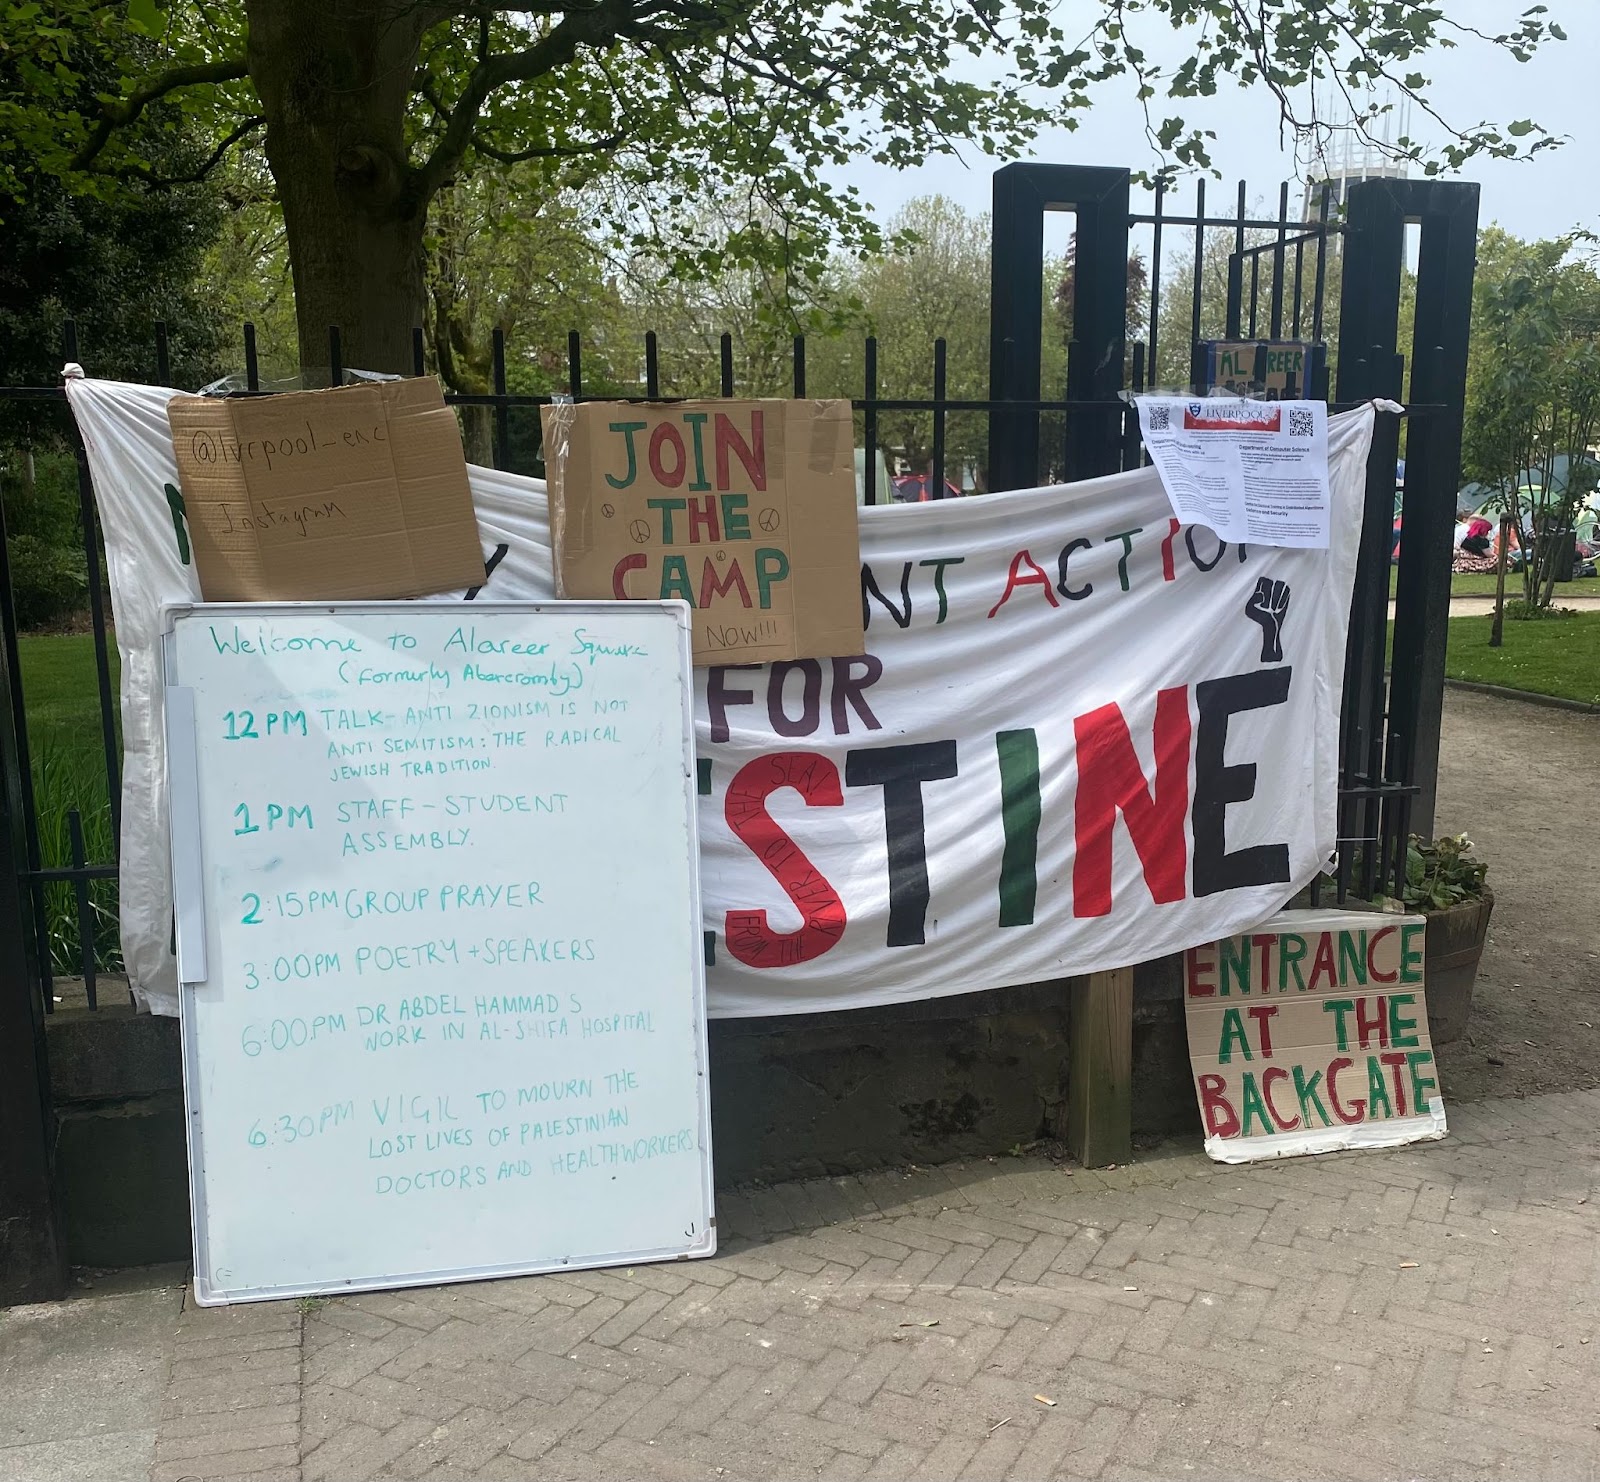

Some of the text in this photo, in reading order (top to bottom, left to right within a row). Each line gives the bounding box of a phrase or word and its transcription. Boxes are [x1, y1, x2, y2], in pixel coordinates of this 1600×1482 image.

[1220, 350, 1303, 377] ALREER
[1206, 408, 1264, 419] LIVERPOOL
[605, 410, 767, 492] JOIN
[647, 493, 752, 545] THE
[612, 548, 790, 610] CAMP
[988, 517, 1247, 620] ACTIO
[208, 625, 363, 656] Welcome
[443, 626, 551, 655] Alareer
[706, 619, 778, 648] NOW!!!
[405, 706, 452, 725] ANTI
[467, 702, 551, 720] ZIONISM
[560, 702, 577, 716] IS
[594, 699, 629, 715] NOT
[707, 653, 884, 744] FOR
[327, 741, 373, 759] ANTI
[492, 730, 527, 748] THE
[545, 725, 622, 748] RADICAL
[329, 762, 390, 782] JEWISH
[697, 666, 1291, 968] STINE
[728, 782, 766, 831] THE
[342, 827, 475, 857] ASSEMBLY.
[763, 837, 797, 873] TO
[344, 887, 430, 919] GROUP
[439, 881, 544, 912] PRAYER
[731, 915, 770, 961] FROM
[777, 933, 805, 964] THE
[242, 952, 342, 990] 3:00PM
[355, 937, 460, 975] POETRY
[1186, 923, 1426, 998] ENTRANCE
[356, 1003, 392, 1027] DR
[399, 994, 467, 1022] ABDEL
[474, 993, 559, 1017] HAMMAD
[442, 1022, 465, 1041] IN
[479, 1017, 569, 1041] AL-SHIFA
[581, 1010, 656, 1040] HOSPITAL
[1218, 993, 1420, 1065] AT THE
[372, 1093, 459, 1127] VIGIL
[475, 1089, 507, 1115] TO
[517, 1078, 593, 1107] MOURN
[603, 1068, 640, 1095] THE
[1197, 1050, 1437, 1140] BACKGATE
[368, 1105, 630, 1159] LOST LIVES OF PALESTINIAN
[375, 1164, 488, 1195] DOCTORS
[496, 1159, 532, 1181] AND
